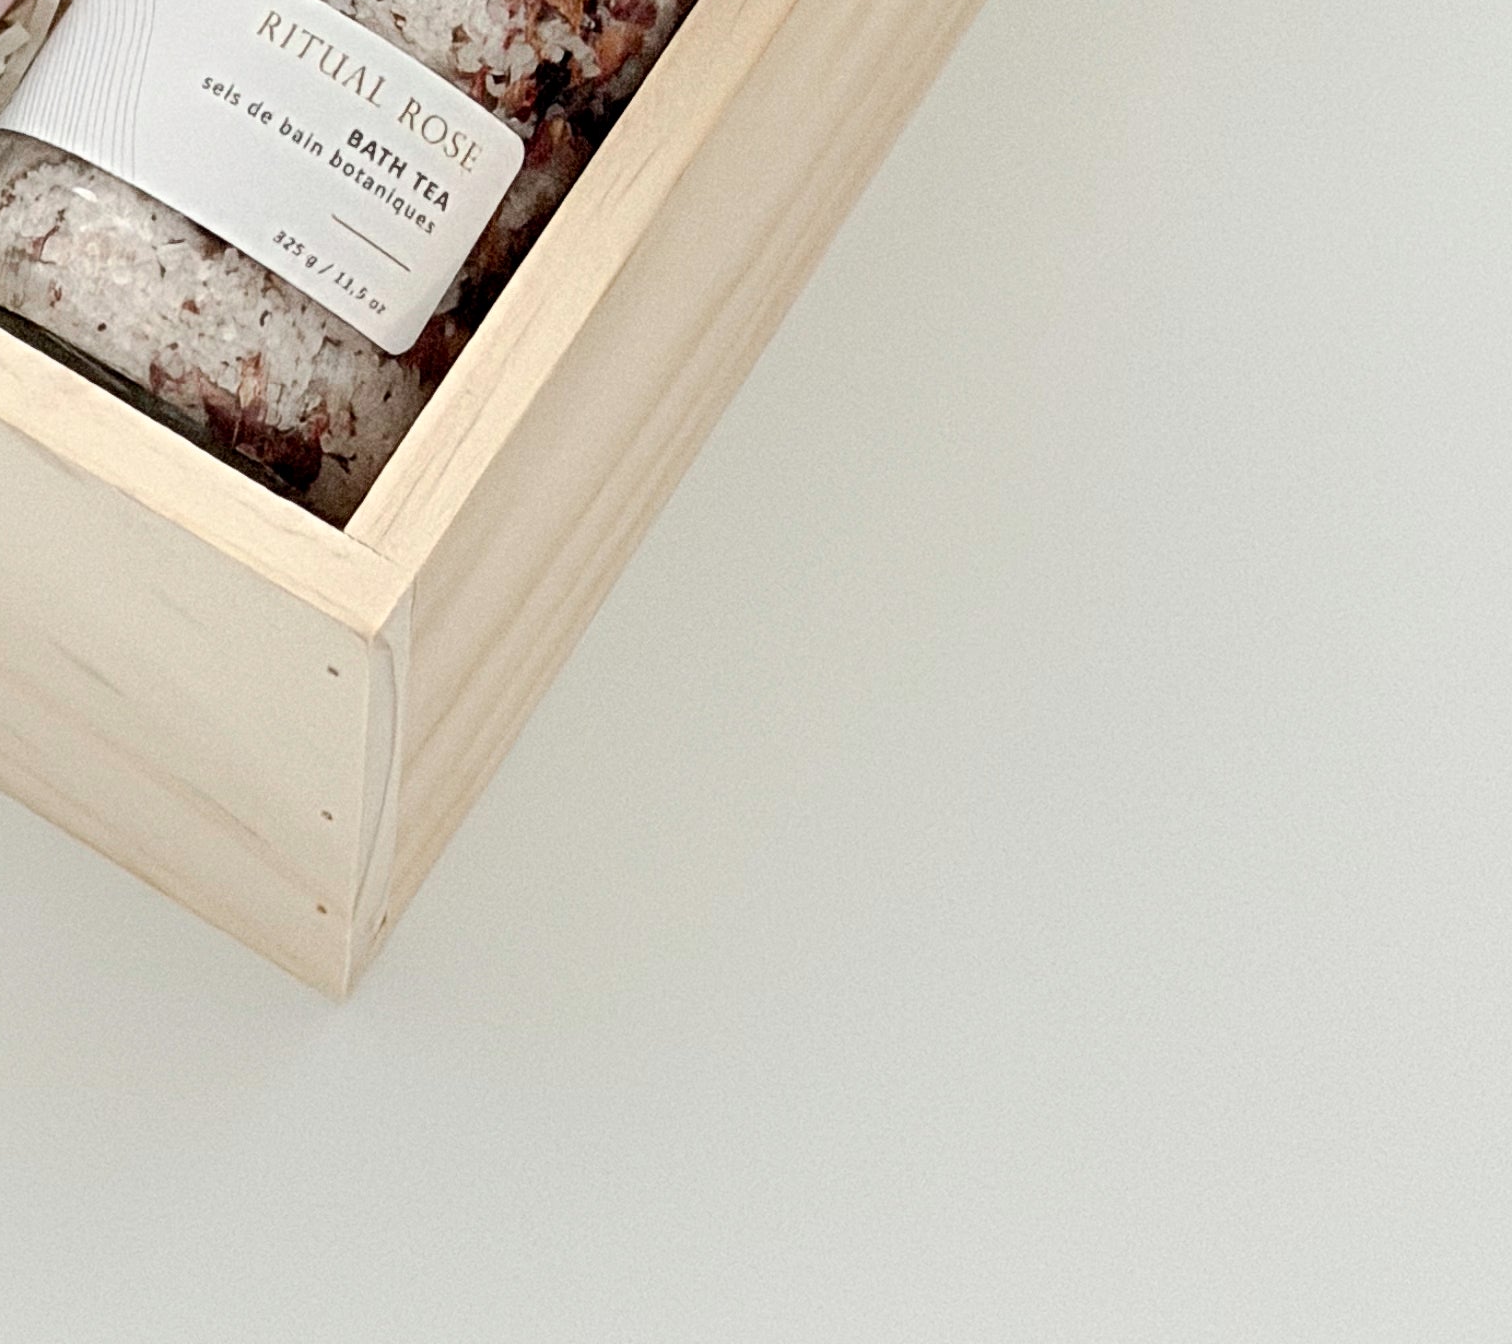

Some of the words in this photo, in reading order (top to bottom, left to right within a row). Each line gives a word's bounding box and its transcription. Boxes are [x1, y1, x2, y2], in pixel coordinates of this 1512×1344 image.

[256, 9, 390, 109] RITUAL
[397, 96, 484, 175] ROSE
[201, 74, 242, 108] sels
[247, 95, 273, 127] de
[278, 116, 324, 158] bain
[328, 148, 436, 236] botaniques
[346, 128, 407, 180] BATH
[412, 170, 451, 213] TEA
[272, 229, 306, 257] 325
[368, 298, 387, 315] oz
